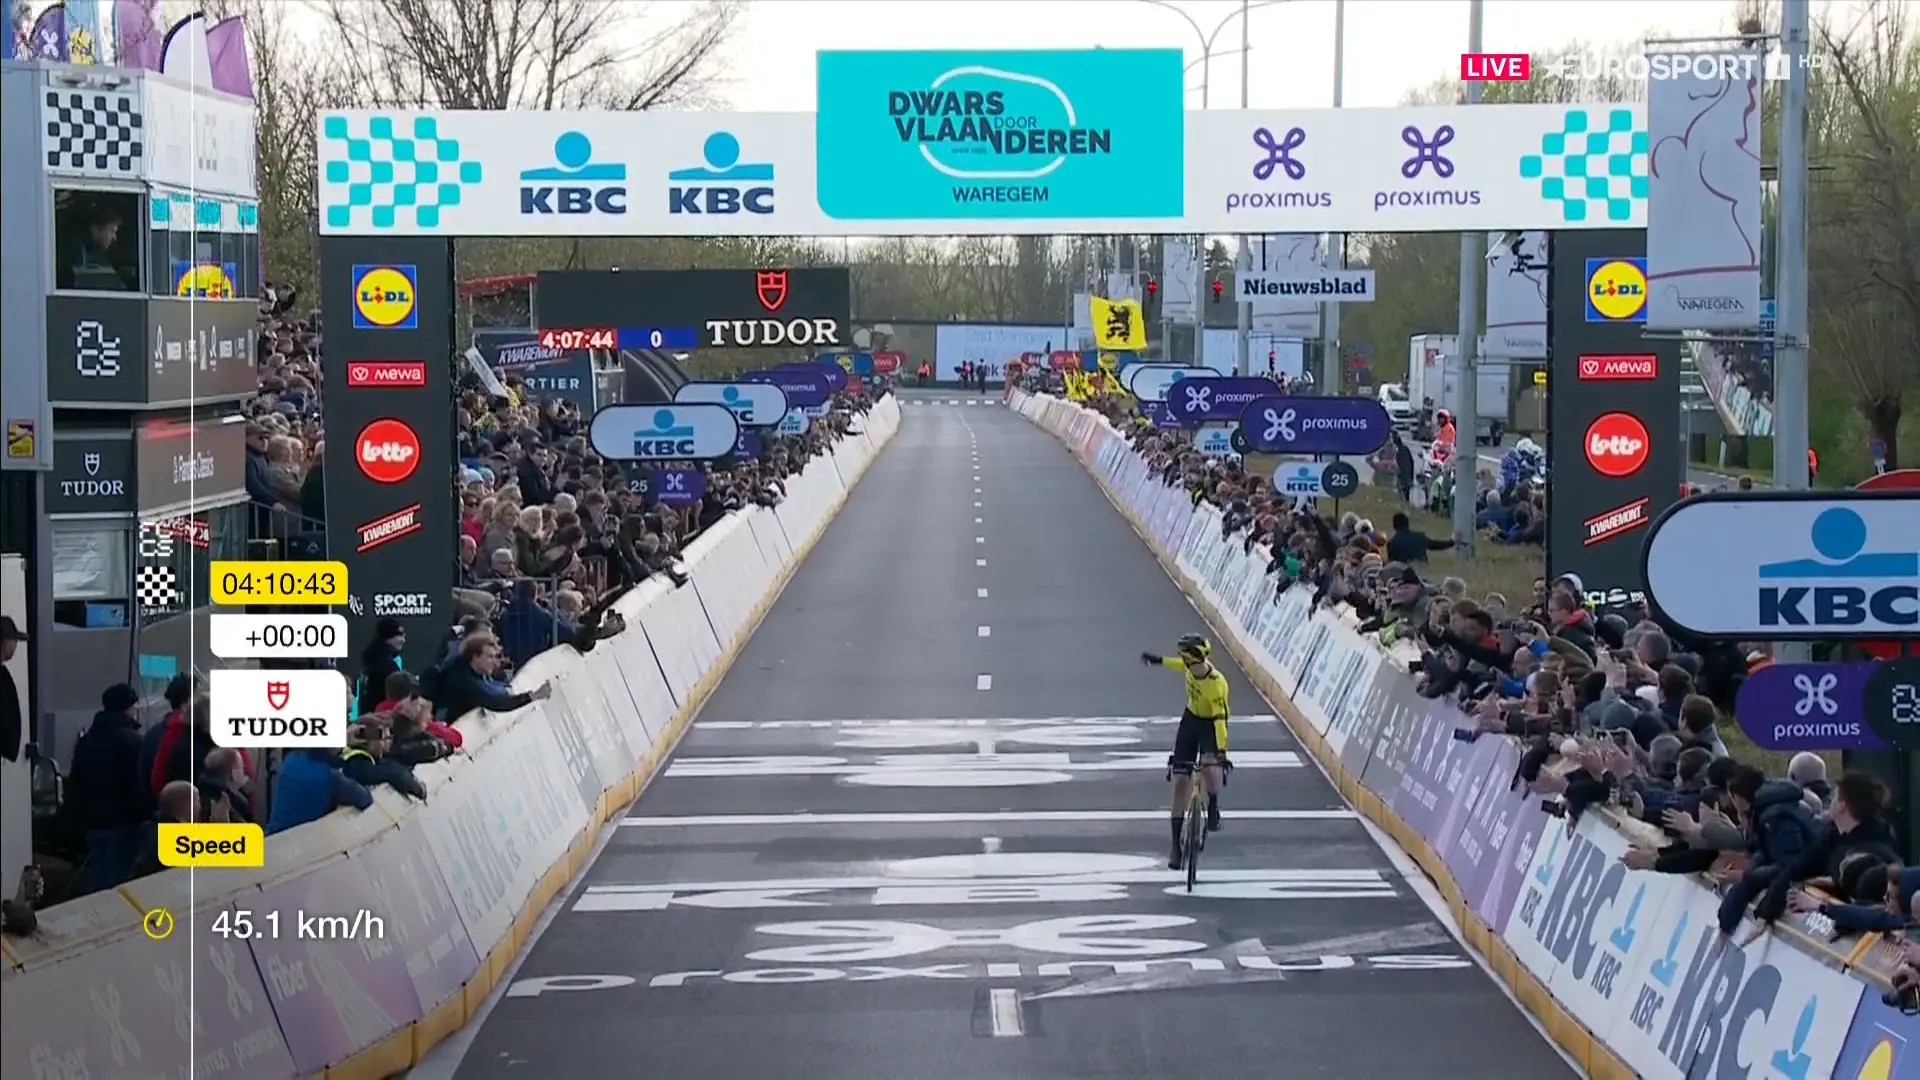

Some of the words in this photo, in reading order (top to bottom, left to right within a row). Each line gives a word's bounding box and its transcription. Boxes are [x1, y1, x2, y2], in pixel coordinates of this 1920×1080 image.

[888, 91, 1005, 116] DWARS
[994, 116, 1037, 128] DOOR
[520, 187, 627, 215] KBC
[669, 187, 775, 215] KBC
[952, 186, 1049, 202] WAREGEM
[1226, 190, 1332, 213] proximus
[1374, 188, 1481, 212] proximus
[1243, 277, 1367, 295] Nieuwsblad
[542, 330, 615, 349] 4:07:44
[651, 331, 662, 348] 0
[706, 319, 840, 346] TUDOR
[781, 383, 816, 393] roximus
[1302, 416, 1368, 432] proximus
[362, 439, 414, 463] lotto
[634, 439, 695, 457] KBC
[1590, 433, 1642, 456] lotto
[60, 480, 125, 496] TUDOR
[630, 480, 648, 493] 25
[1286, 482, 1319, 493] KBC
[1331, 473, 1349, 487] 25
[362, 511, 415, 545] KWAREMONT
[1589, 505, 1642, 537] KWAREMONT
[373, 606, 432, 616] VLAANDEREN
[1759, 585, 1919, 626] KBC
[1773, 722, 1861, 742] proximus
[571, 880, 1398, 912] KBC
[1519, 885, 1542, 929] KBC
[1536, 832, 1627, 981] KBC
[503, 953, 1475, 998] proximus
[1590, 950, 1623, 1000] KBC
[1630, 982, 1665, 1035] KBC
[1657, 923, 1783, 1080] KBC
